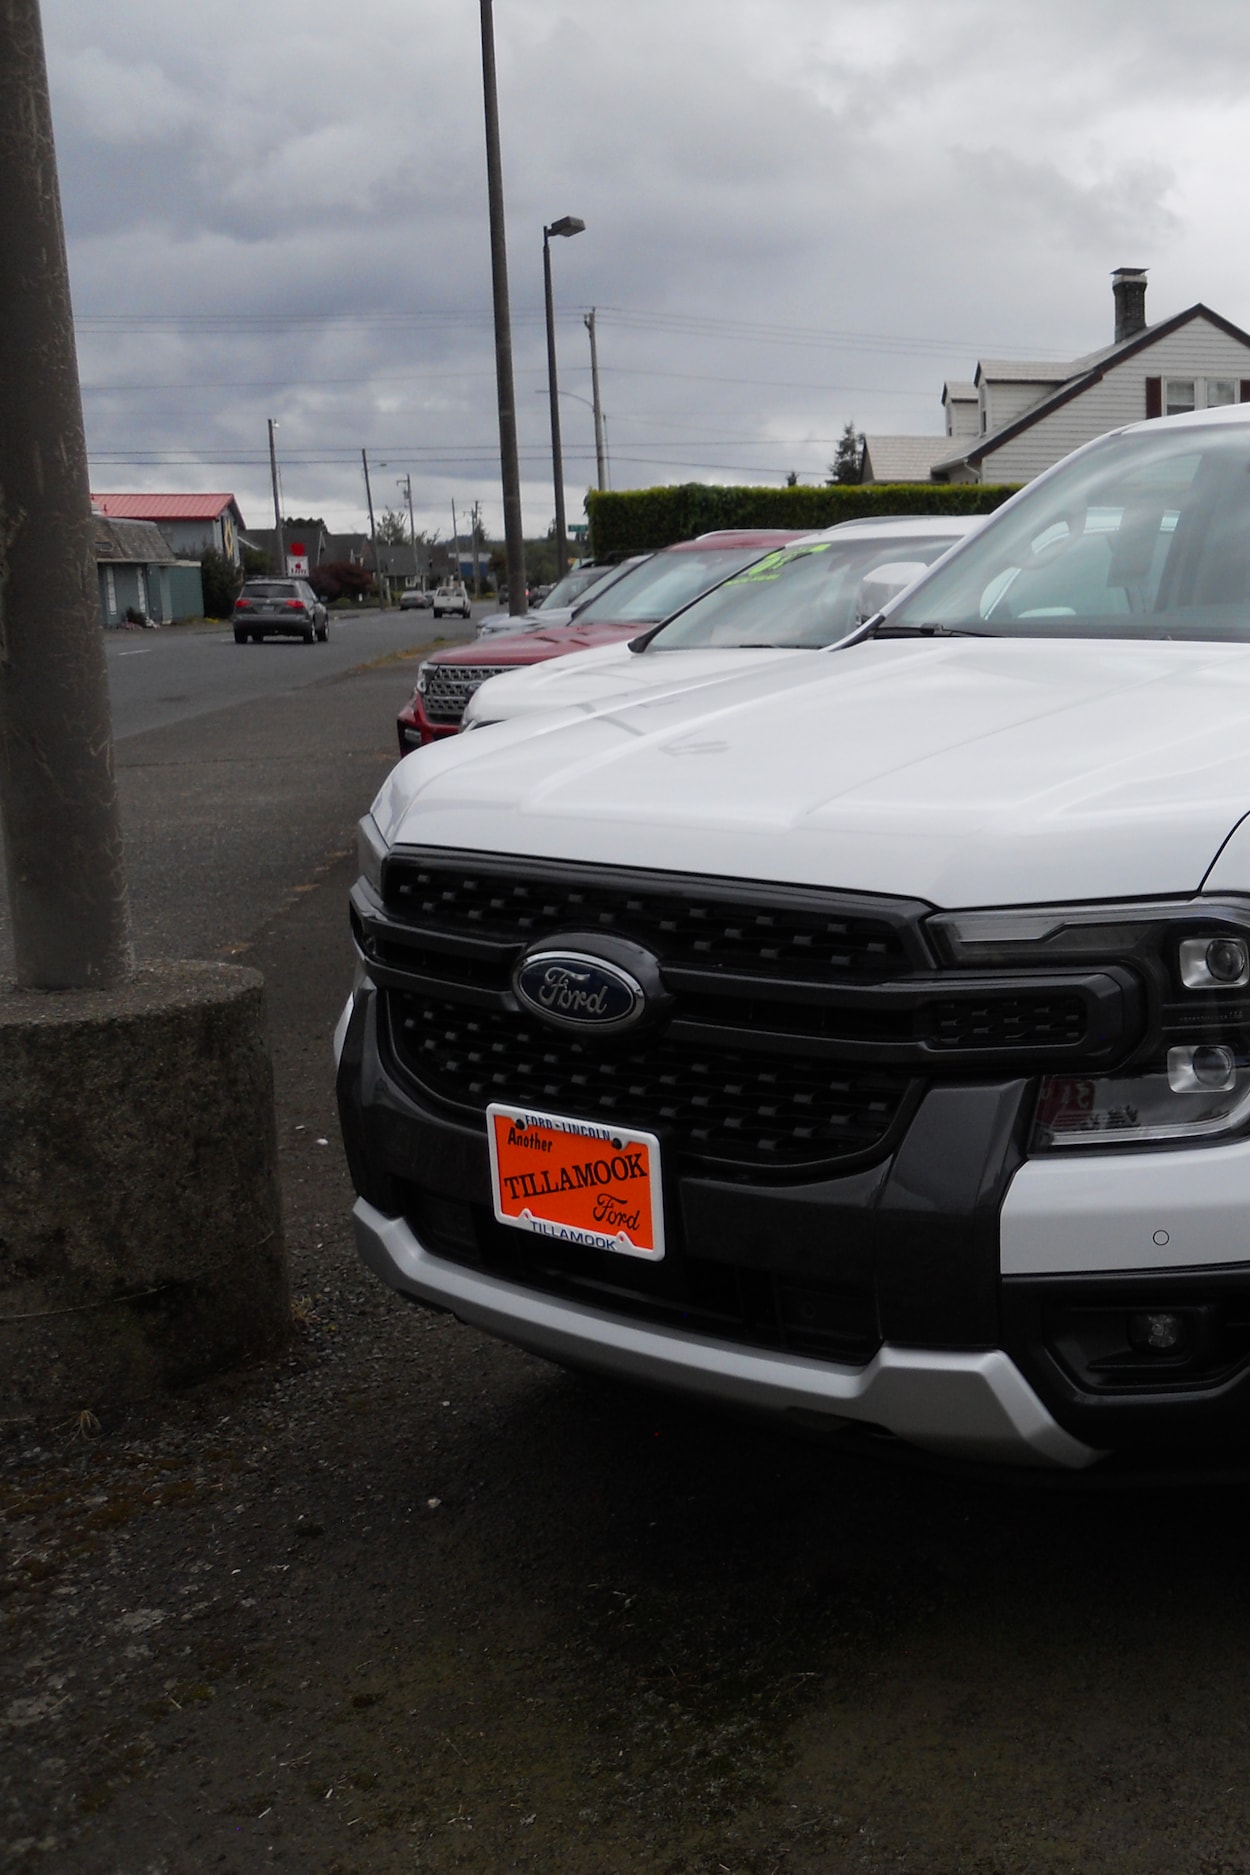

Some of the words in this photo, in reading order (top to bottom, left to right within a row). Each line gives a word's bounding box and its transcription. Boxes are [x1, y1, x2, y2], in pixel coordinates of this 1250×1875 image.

[538, 966, 609, 1014] Ford
[507, 1127, 553, 1153] Another
[525, 1114, 552, 1130] FORD
[562, 1122, 611, 1141] LINCOLN
[504, 1153, 647, 1199] TILLAMOOK
[592, 1193, 641, 1231] Ford
[530, 1220, 617, 1251] TILLAMOOK
